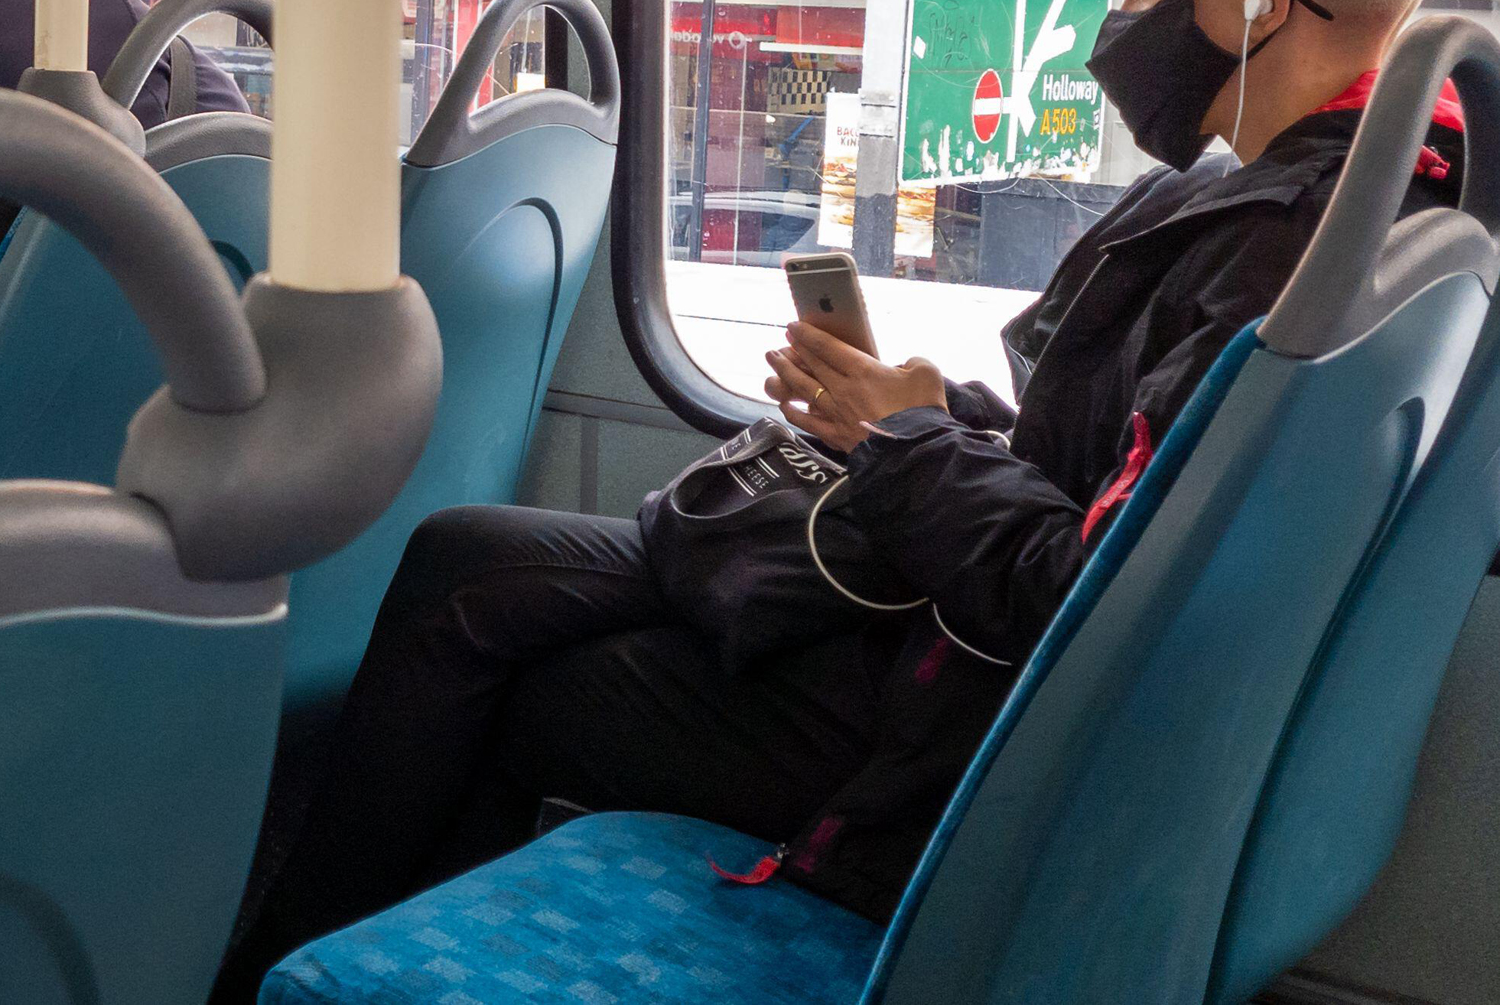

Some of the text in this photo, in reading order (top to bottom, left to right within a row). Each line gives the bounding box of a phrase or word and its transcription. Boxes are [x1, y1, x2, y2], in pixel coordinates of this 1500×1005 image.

[1042, 74, 1100, 106] Holloway
[836, 125, 859, 137] BAC
[840, 137, 857, 147] KIN
[744, 464, 770, 490] HEESE
